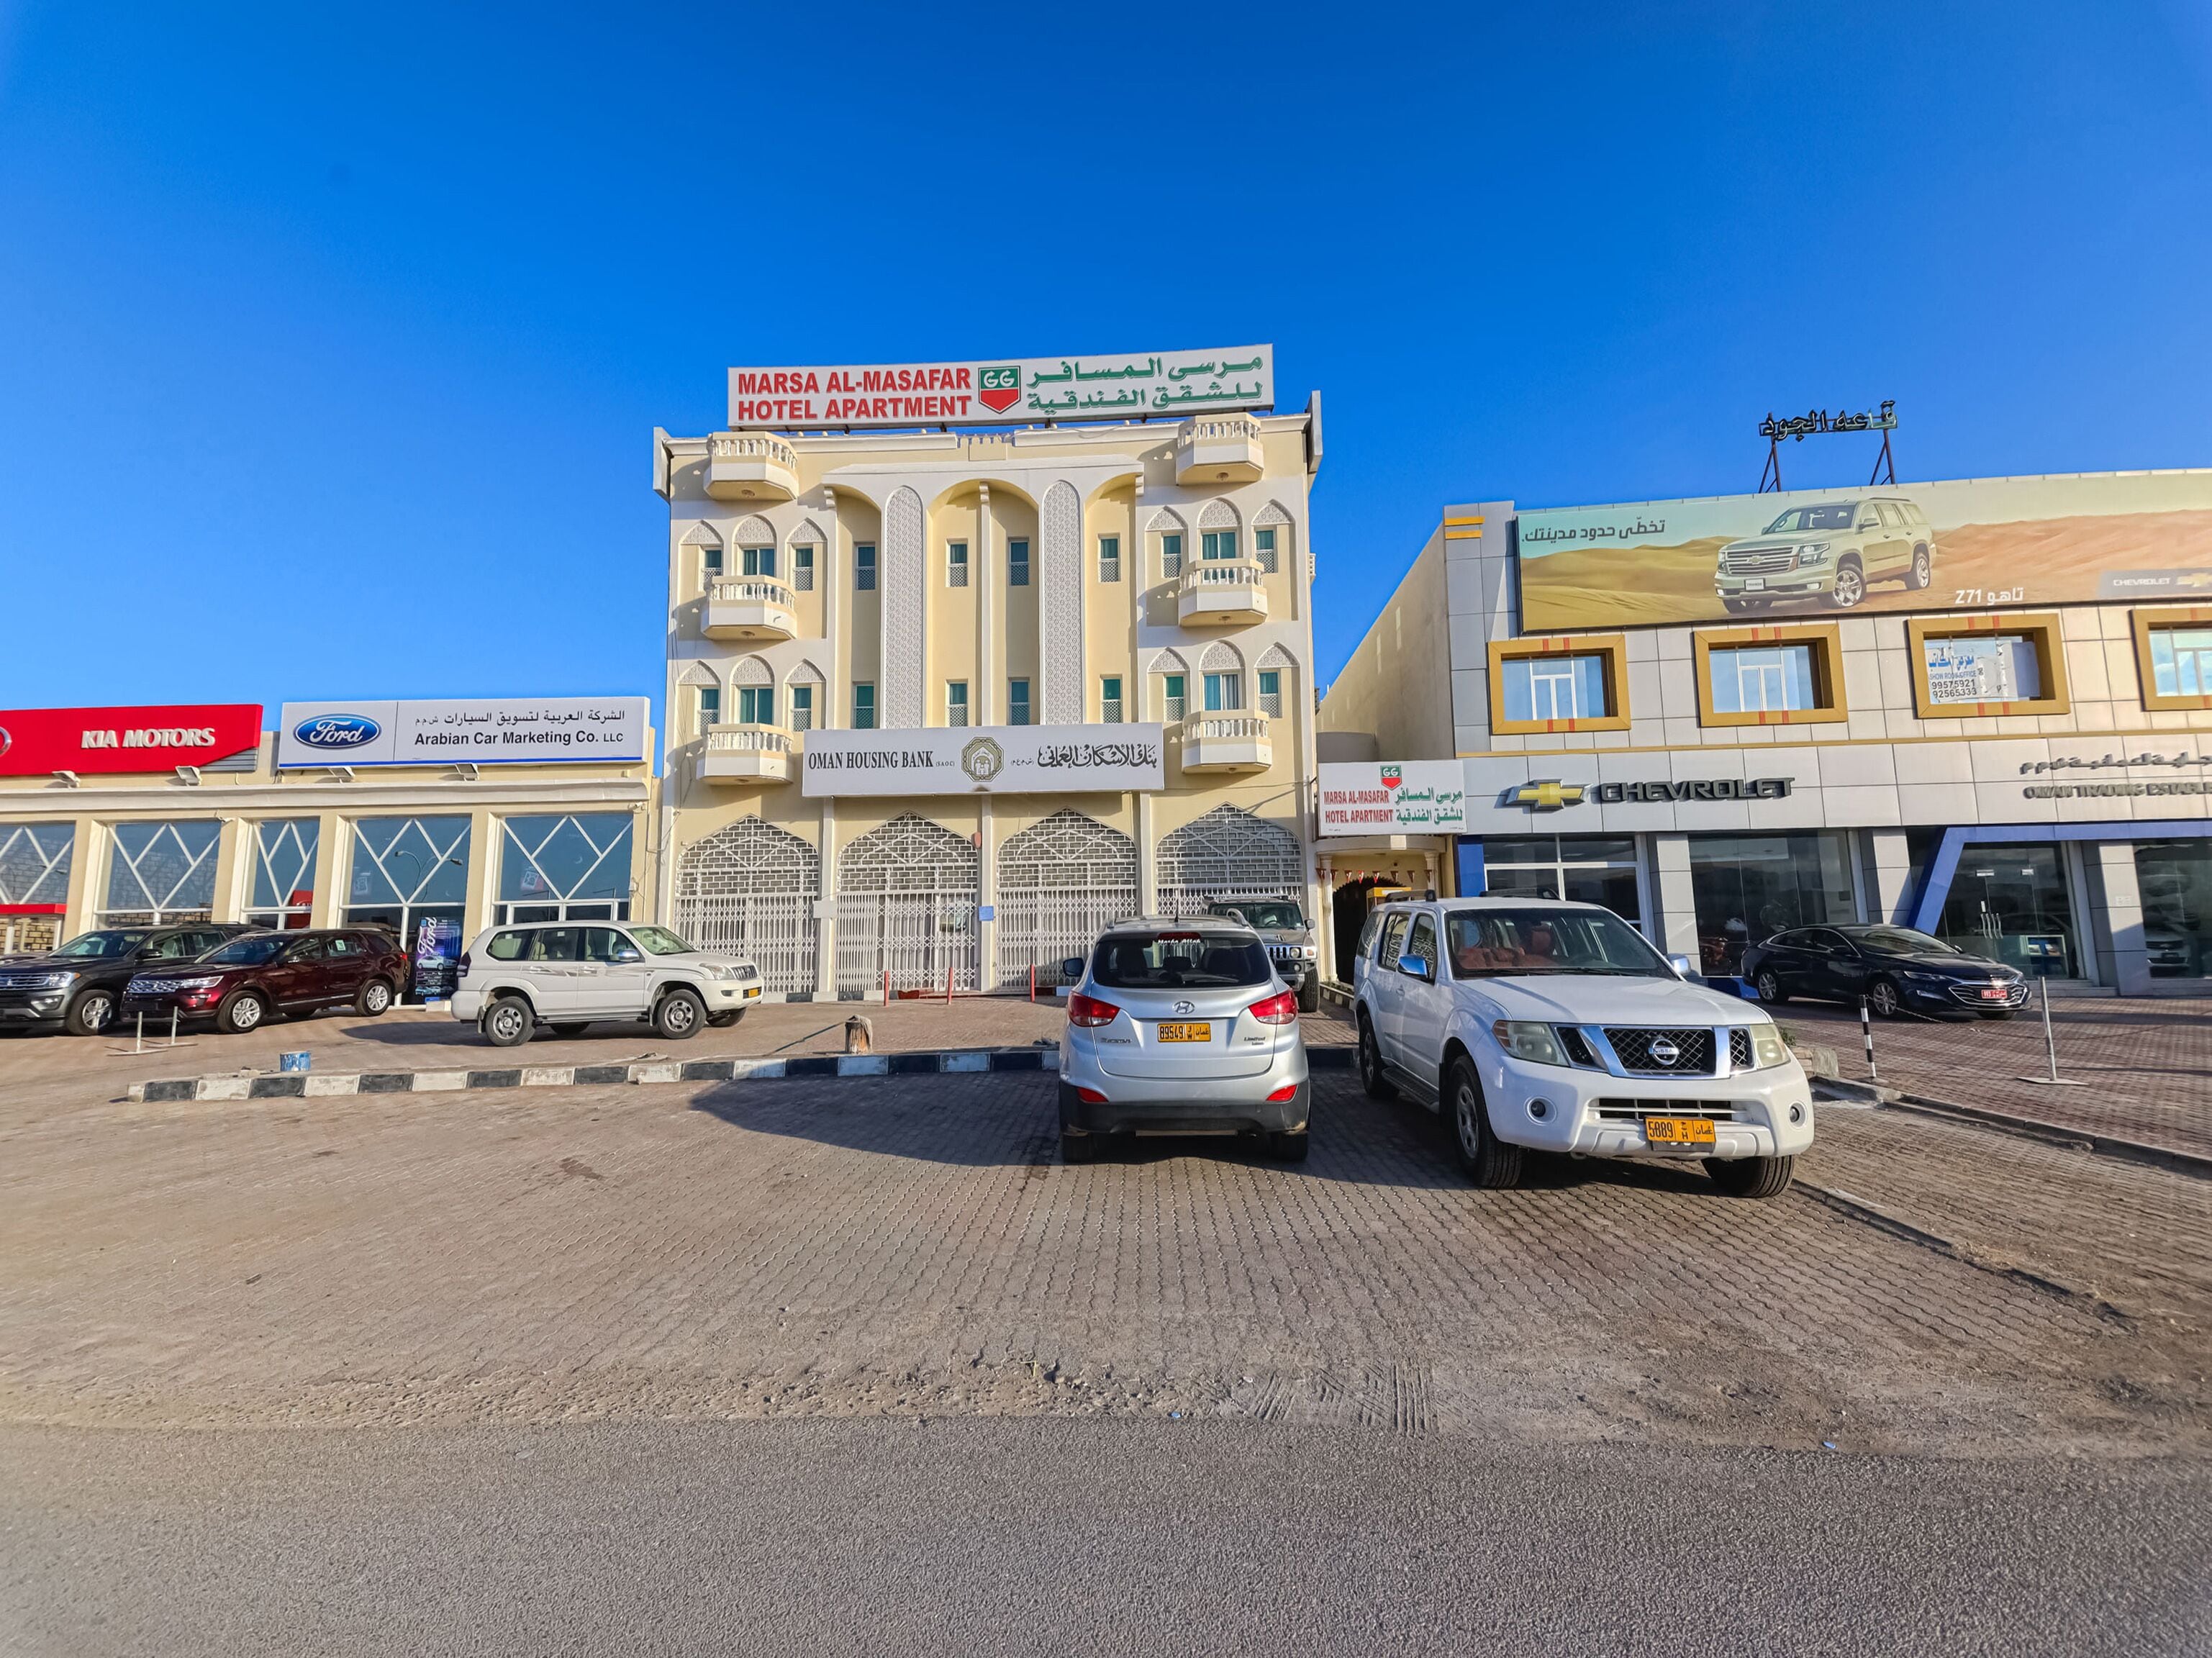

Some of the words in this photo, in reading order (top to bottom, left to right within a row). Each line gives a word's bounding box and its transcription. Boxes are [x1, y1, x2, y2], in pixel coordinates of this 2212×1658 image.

[1026, 357, 1162, 388] المسافر
[1167, 355, 1264, 381] مرسى
[738, 371, 820, 394] MARSA
[826, 368, 971, 393] AL-MASAFAR
[1027, 388, 1146, 414] الفندقية
[1151, 381, 1264, 409] للشقق
[738, 399, 817, 420] HOTEL
[825, 395, 971, 420] APARTMENT
[1580, 526, 1616, 541] حدود
[1955, 589, 1982, 604] Z71
[1987, 587, 2023, 606] تاهو
[1931, 679, 1975, 689] 99575921
[1933, 687, 1977, 698] 92565333
[444, 712, 491, 726] السيارات
[497, 711, 538, 726] لتسويق
[543, 710, 582, 725] العربية
[588, 710, 625, 724] الشركة
[81, 730, 118, 748] KIA
[122, 728, 216, 748] MOTORS
[309, 720, 365, 743] Ford
[414, 733, 468, 746] Arabian
[473, 732, 498, 744] Car
[502, 731, 571, 746] Marketing
[576, 730, 599, 743] Co.
[604, 733, 624, 743] LLC
[808, 752, 843, 770] OMAN
[846, 751, 898, 769] HOUSING
[901, 751, 934, 768] BANK
[1323, 791, 1347, 805] MARSA
[1348, 790, 1390, 804] AL-MASAFAR
[1395, 787, 1434, 805] المسافر
[1436, 790, 1463, 805] مرسى
[1600, 777, 1795, 802] CHEVROLET
[1325, 810, 1349, 823] HOTEL
[1351, 809, 1394, 823] APARTMENT
[1396, 808, 1432, 825] الفندقية
[1434, 807, 1463, 825] للشقق
[417, 917, 438, 956] Ford
[1160, 1025, 1184, 1040] 89549
[1648, 1121, 1674, 1138] 5889
[1682, 1131, 1689, 1140] H
